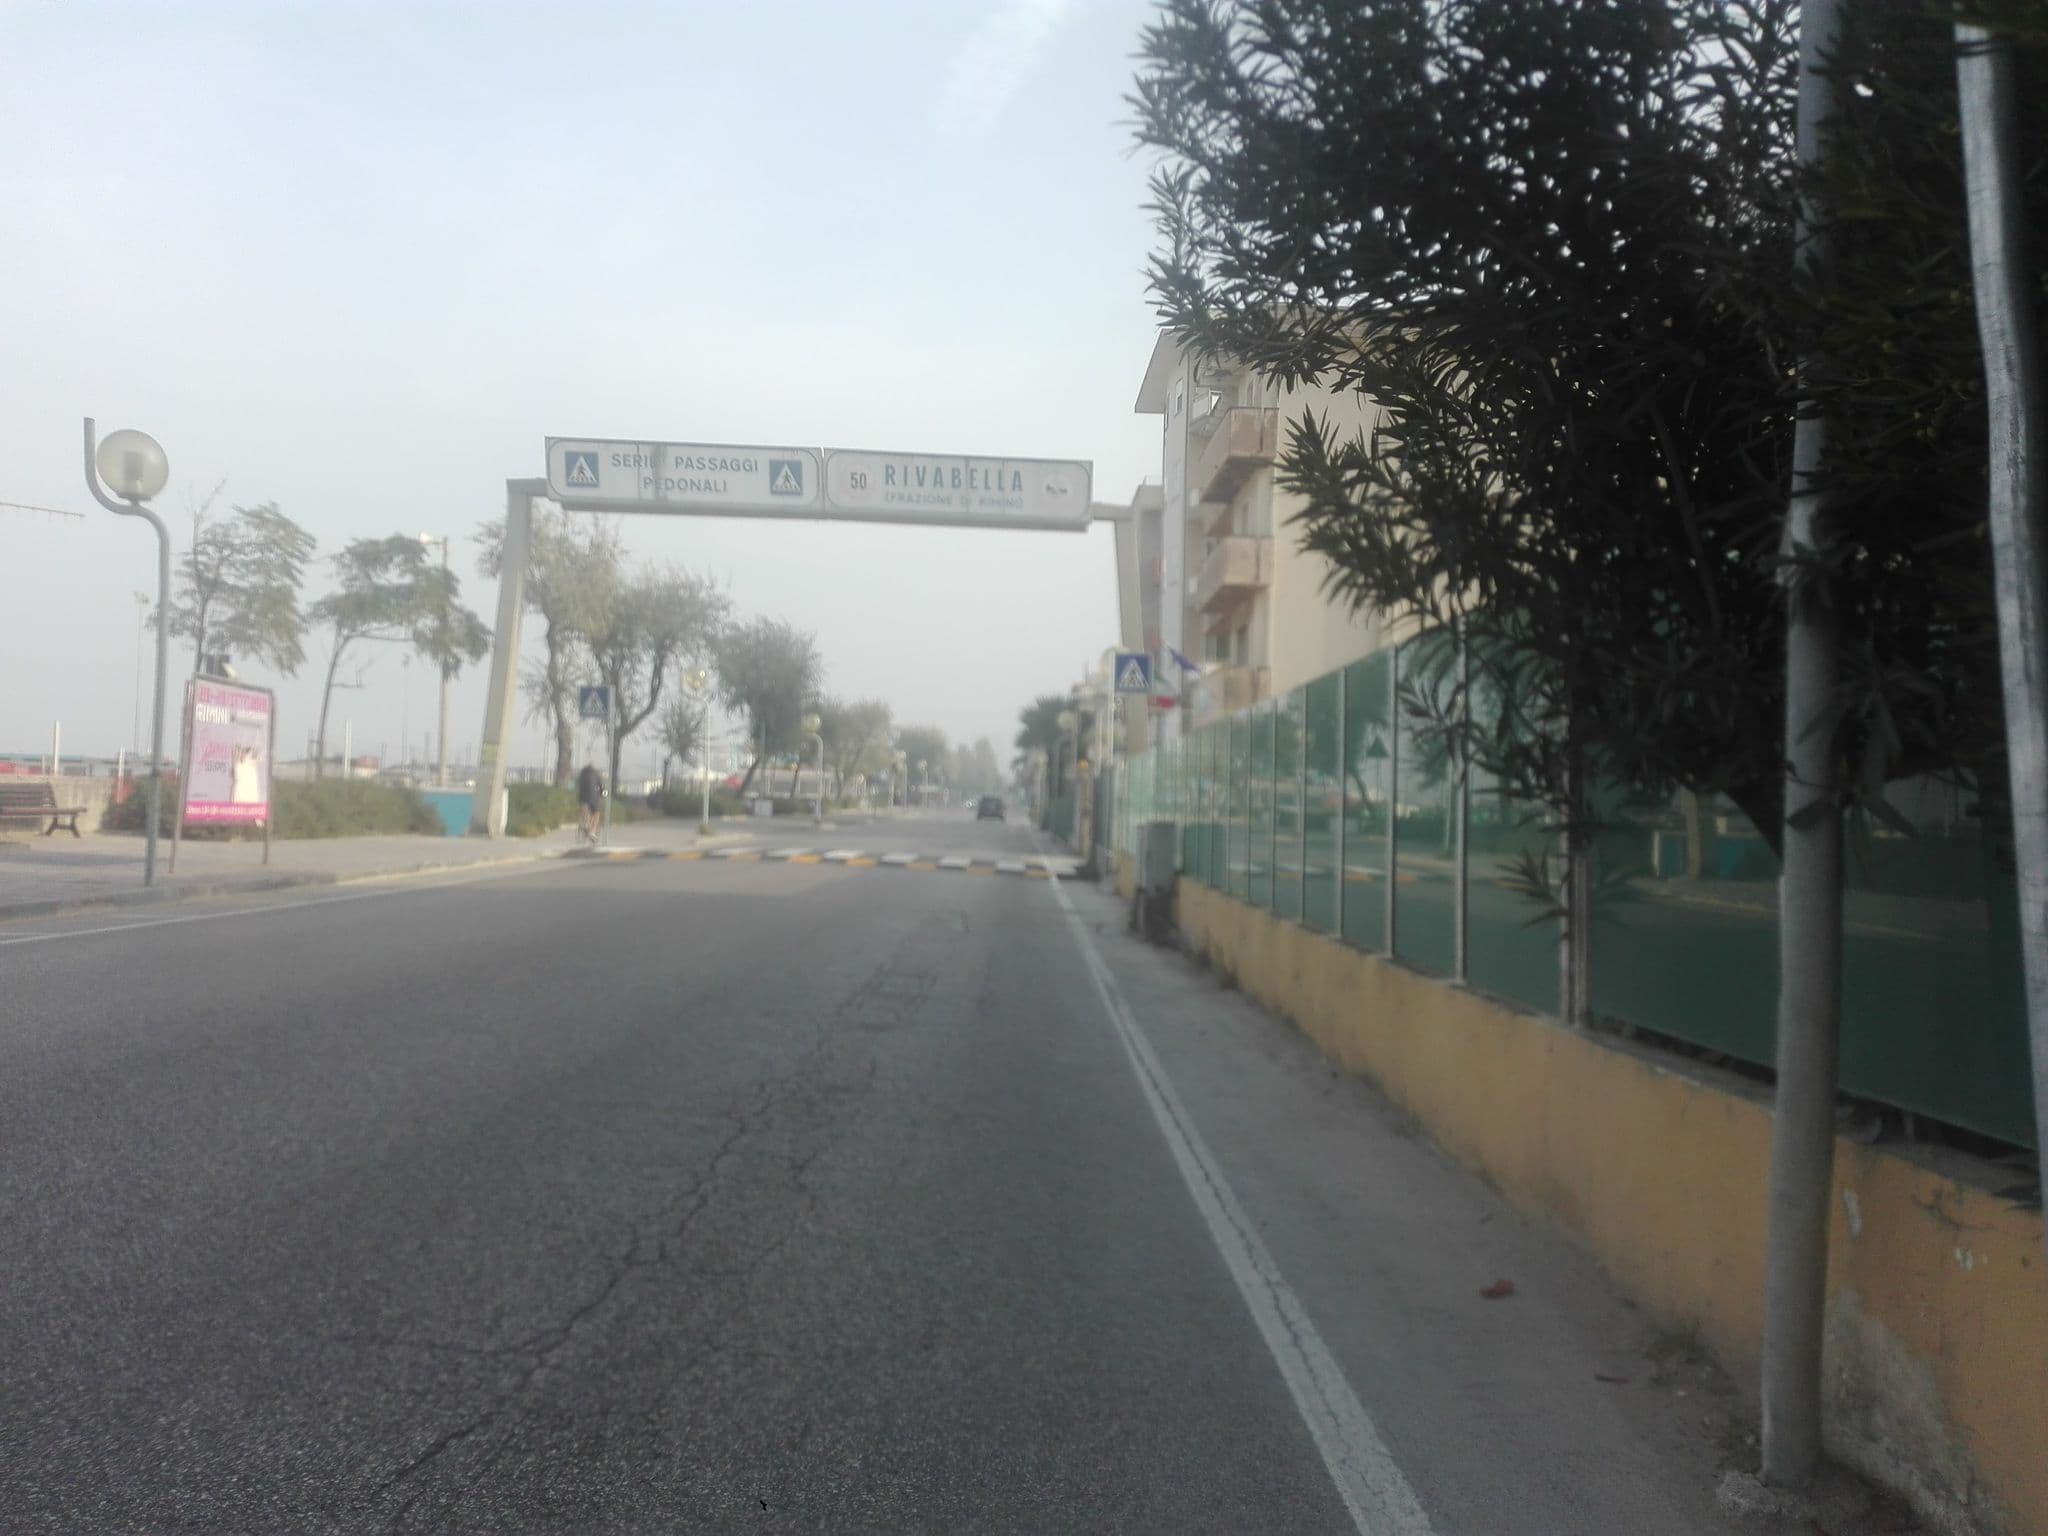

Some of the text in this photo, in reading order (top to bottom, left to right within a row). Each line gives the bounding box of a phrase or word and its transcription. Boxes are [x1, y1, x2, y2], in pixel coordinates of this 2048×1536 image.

[674, 455, 759, 472] PASSAGGI
[643, 476, 728, 493] PEDONALI
[850, 471, 868, 490] 50
[885, 463, 1024, 492] RIVABELLA
